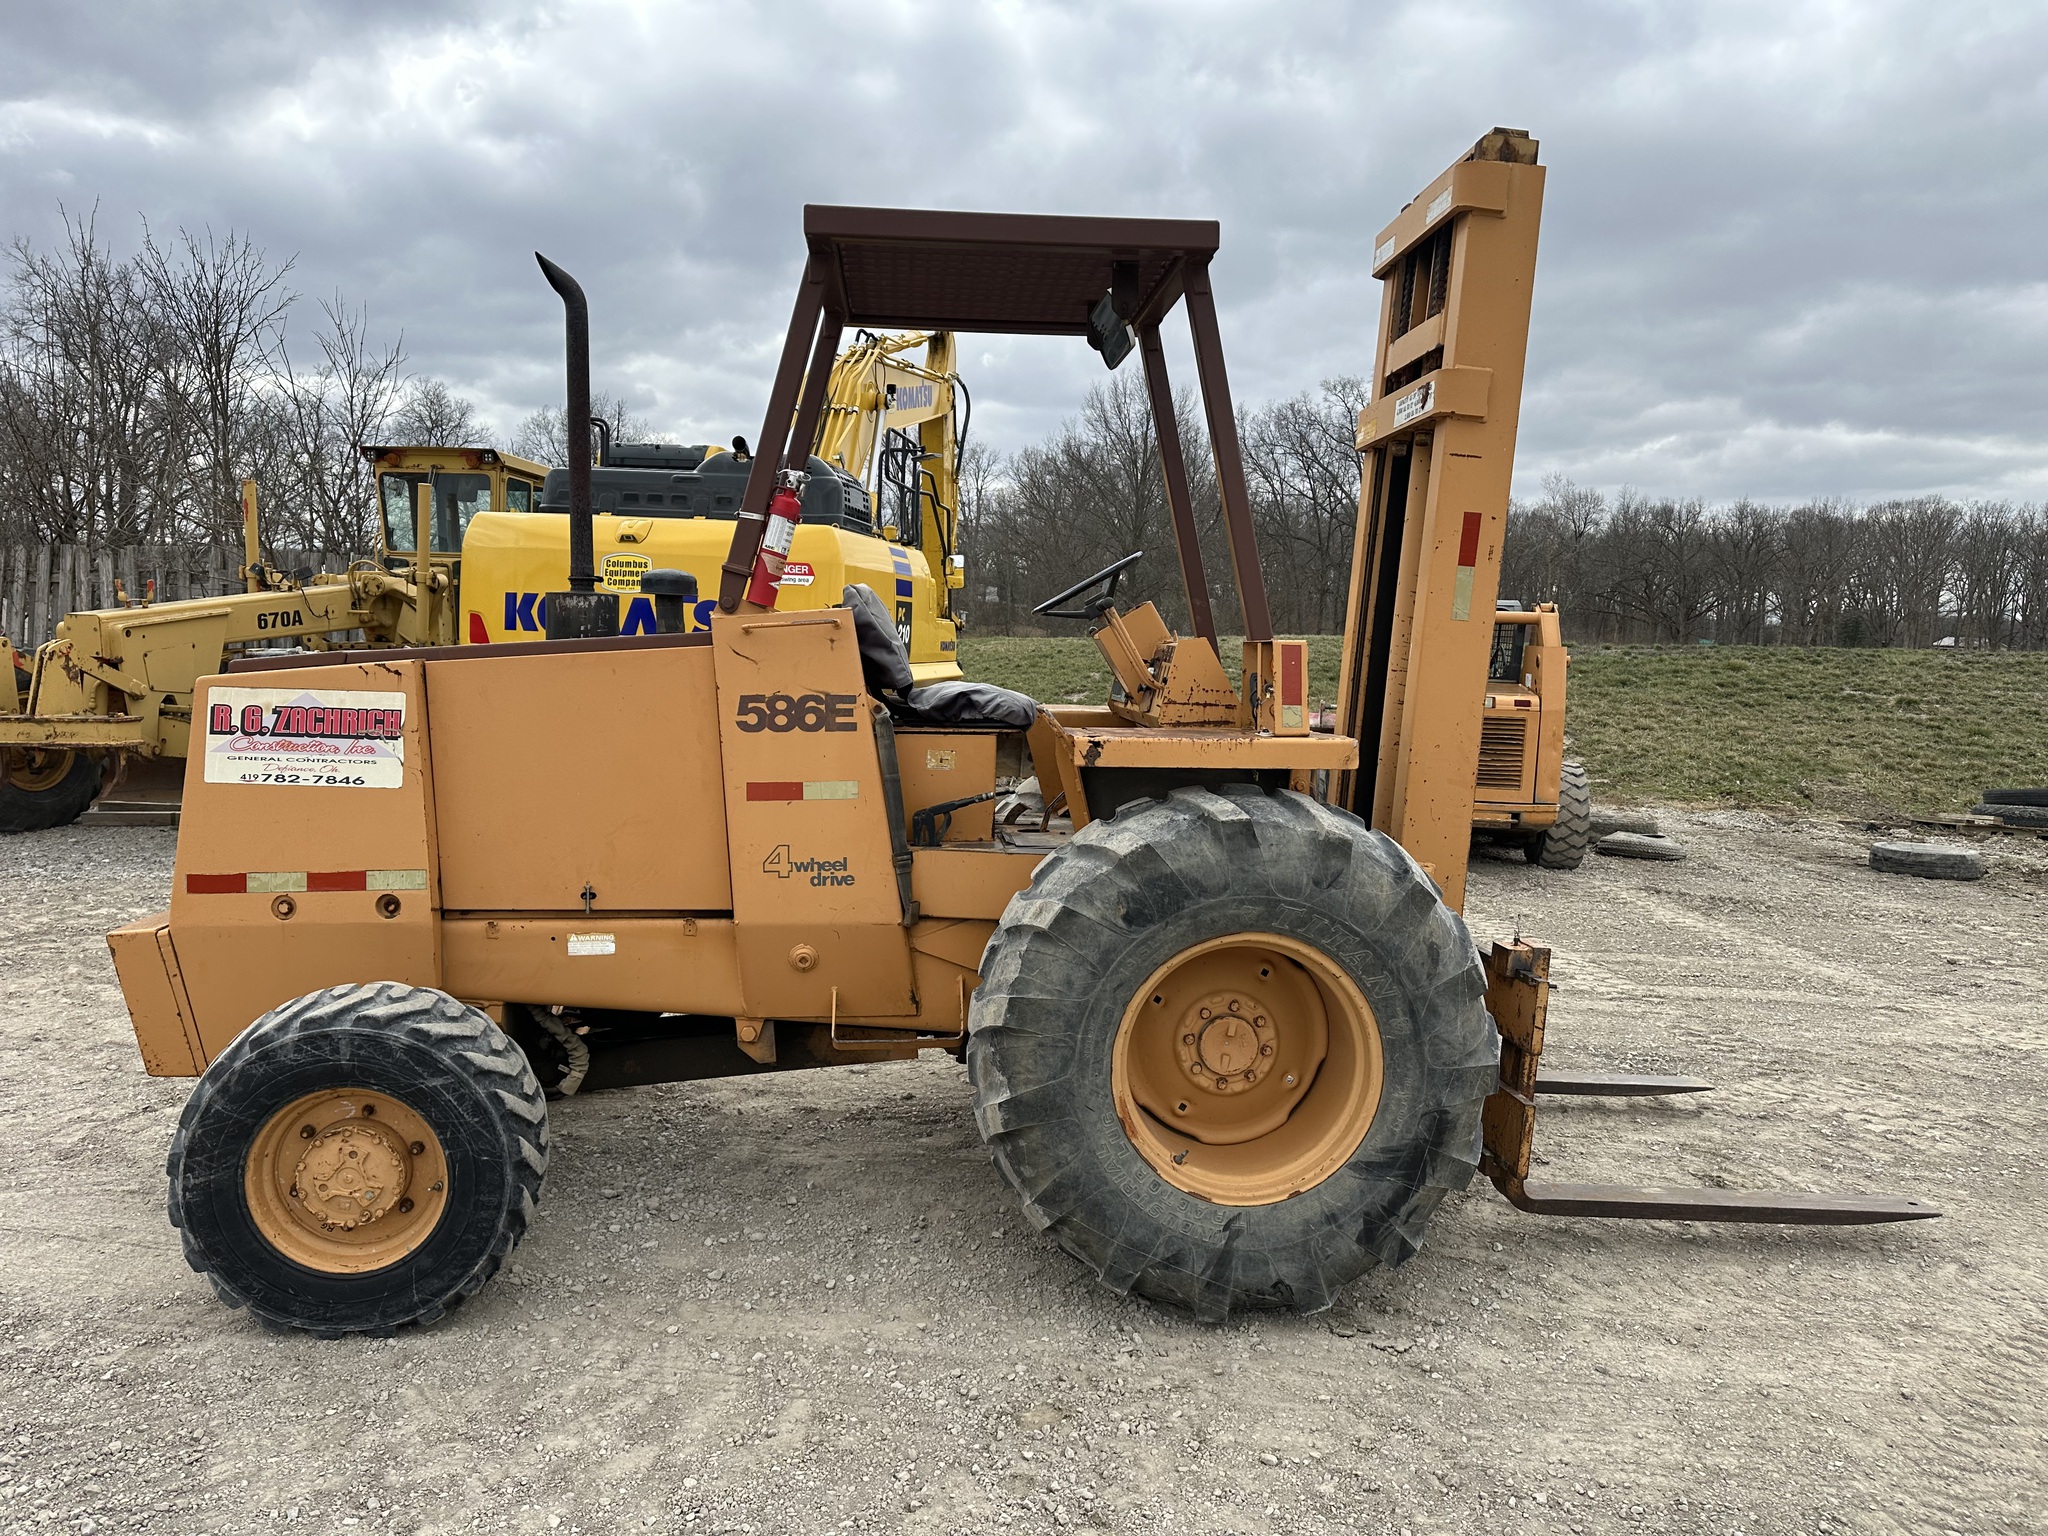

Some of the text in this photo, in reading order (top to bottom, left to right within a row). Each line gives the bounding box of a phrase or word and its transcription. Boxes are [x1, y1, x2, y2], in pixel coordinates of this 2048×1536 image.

[896, 379, 933, 411] KOMATSU
[606, 560, 648, 568] Columbus
[783, 564, 809, 574] NGER
[607, 578, 641, 587] Compan
[257, 609, 304, 631] 670A
[735, 694, 858, 733] 586E
[269, 705, 402, 741] ZACHRICH
[344, 739, 376, 755] Inc.
[227, 755, 377, 765] GENERAL CONTRACTORS
[240, 773, 365, 785] 419 782-7846
[763, 845, 848, 878] 4 wheel
[809, 872, 855, 887] drive
[1271, 903, 1402, 999] TITAN
